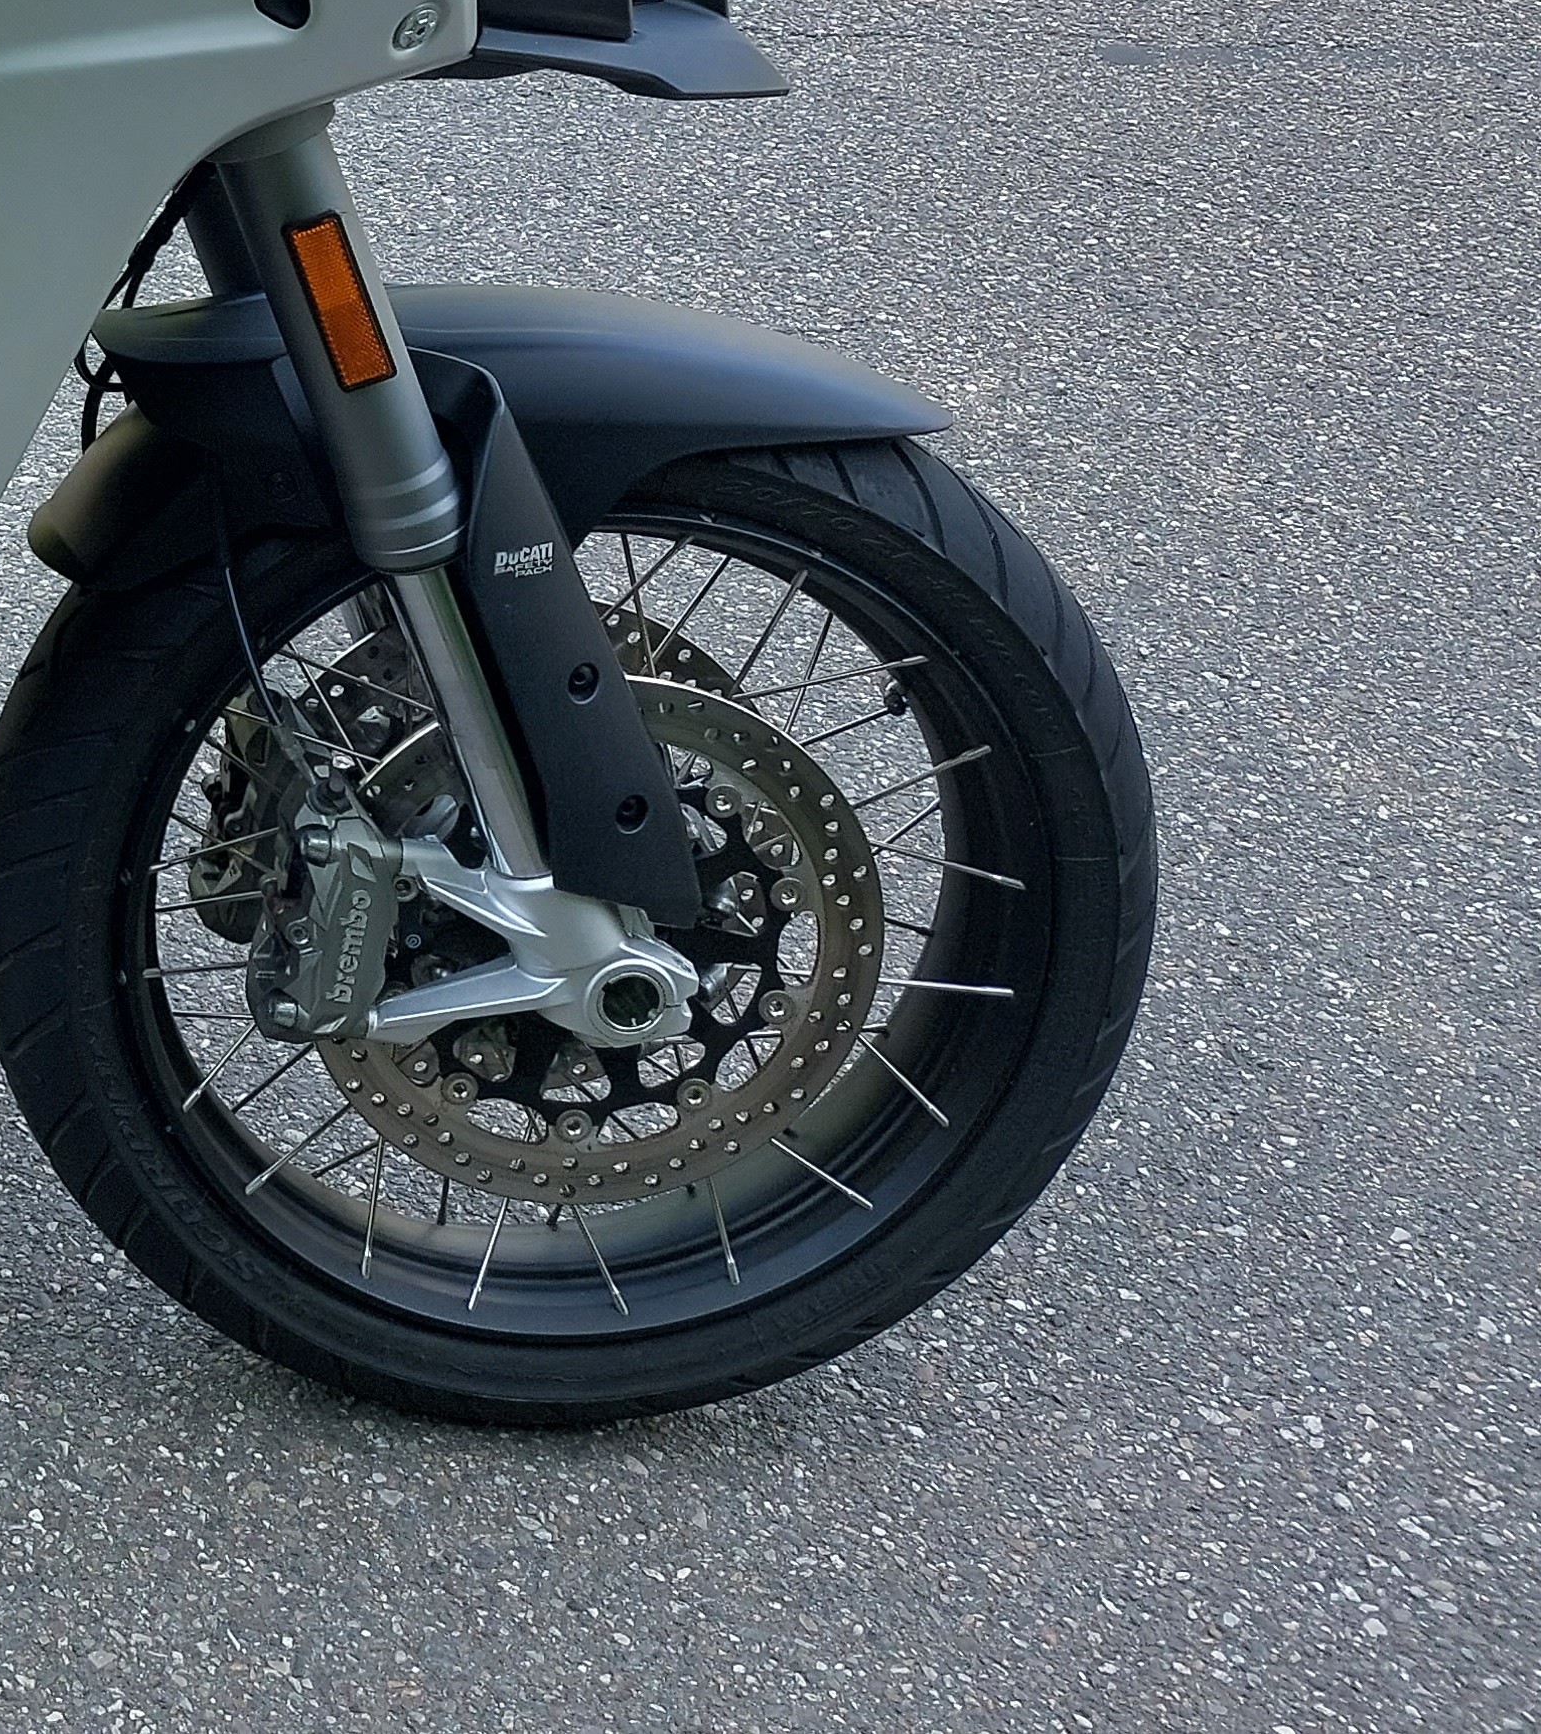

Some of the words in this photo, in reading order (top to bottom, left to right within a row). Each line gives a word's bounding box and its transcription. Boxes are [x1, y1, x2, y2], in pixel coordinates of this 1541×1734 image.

[494, 557, 553, 576] SAFETY
[495, 541, 553, 567] DUCATI
[325, 889, 372, 1003] brembo
